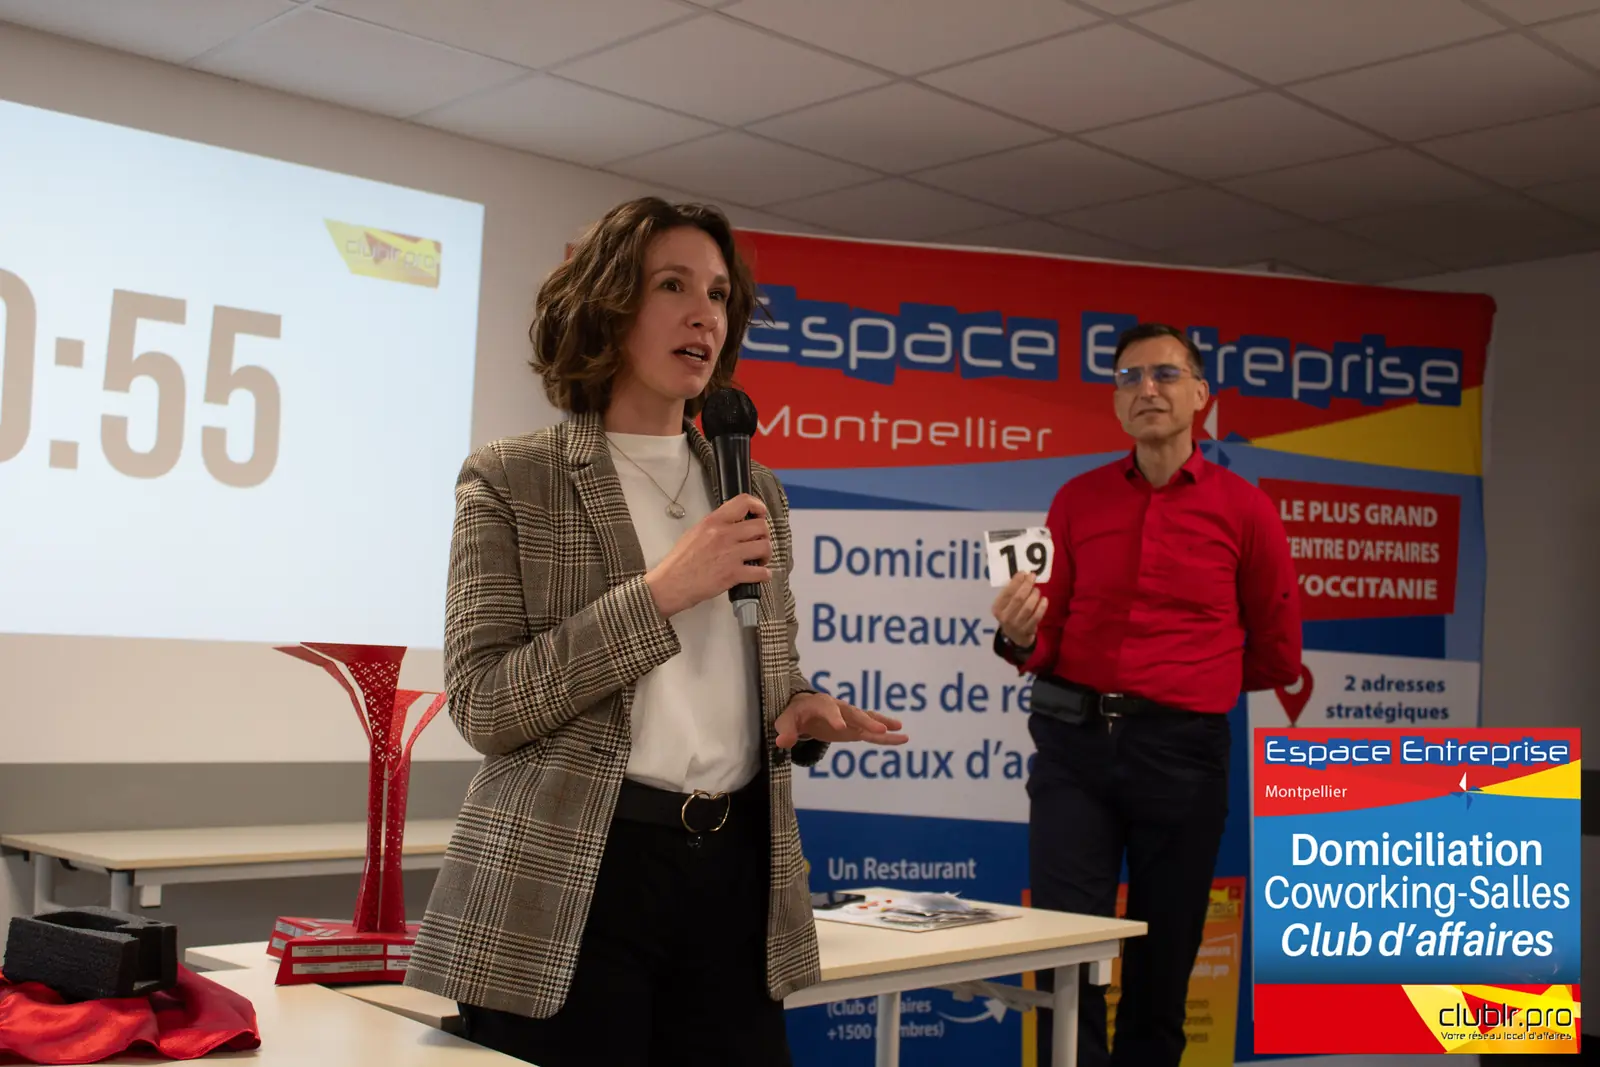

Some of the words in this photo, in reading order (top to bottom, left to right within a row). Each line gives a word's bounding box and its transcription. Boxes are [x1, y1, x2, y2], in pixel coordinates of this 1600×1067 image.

[1086, 323, 1460, 399] Ereprise
[757, 405, 1052, 451] Montpellier
[1280, 499, 1305, 521] LE
[1309, 500, 1361, 524] PLUS
[1364, 504, 1438, 527] GRAND
[813, 535, 990, 580] Domicili
[999, 542, 1047, 580] 19
[1287, 536, 1344, 560] ENTRE
[1347, 540, 1440, 564] D'AFFAIRES
[1298, 574, 1438, 600] 'OCCITANIE
[939, 672, 988, 712] de
[1344, 676, 1356, 692] 2
[1362, 675, 1446, 693] adresses
[1326, 704, 1450, 724] stratégiques
[828, 858, 858, 880] Un
[864, 857, 976, 880] Restaurant
